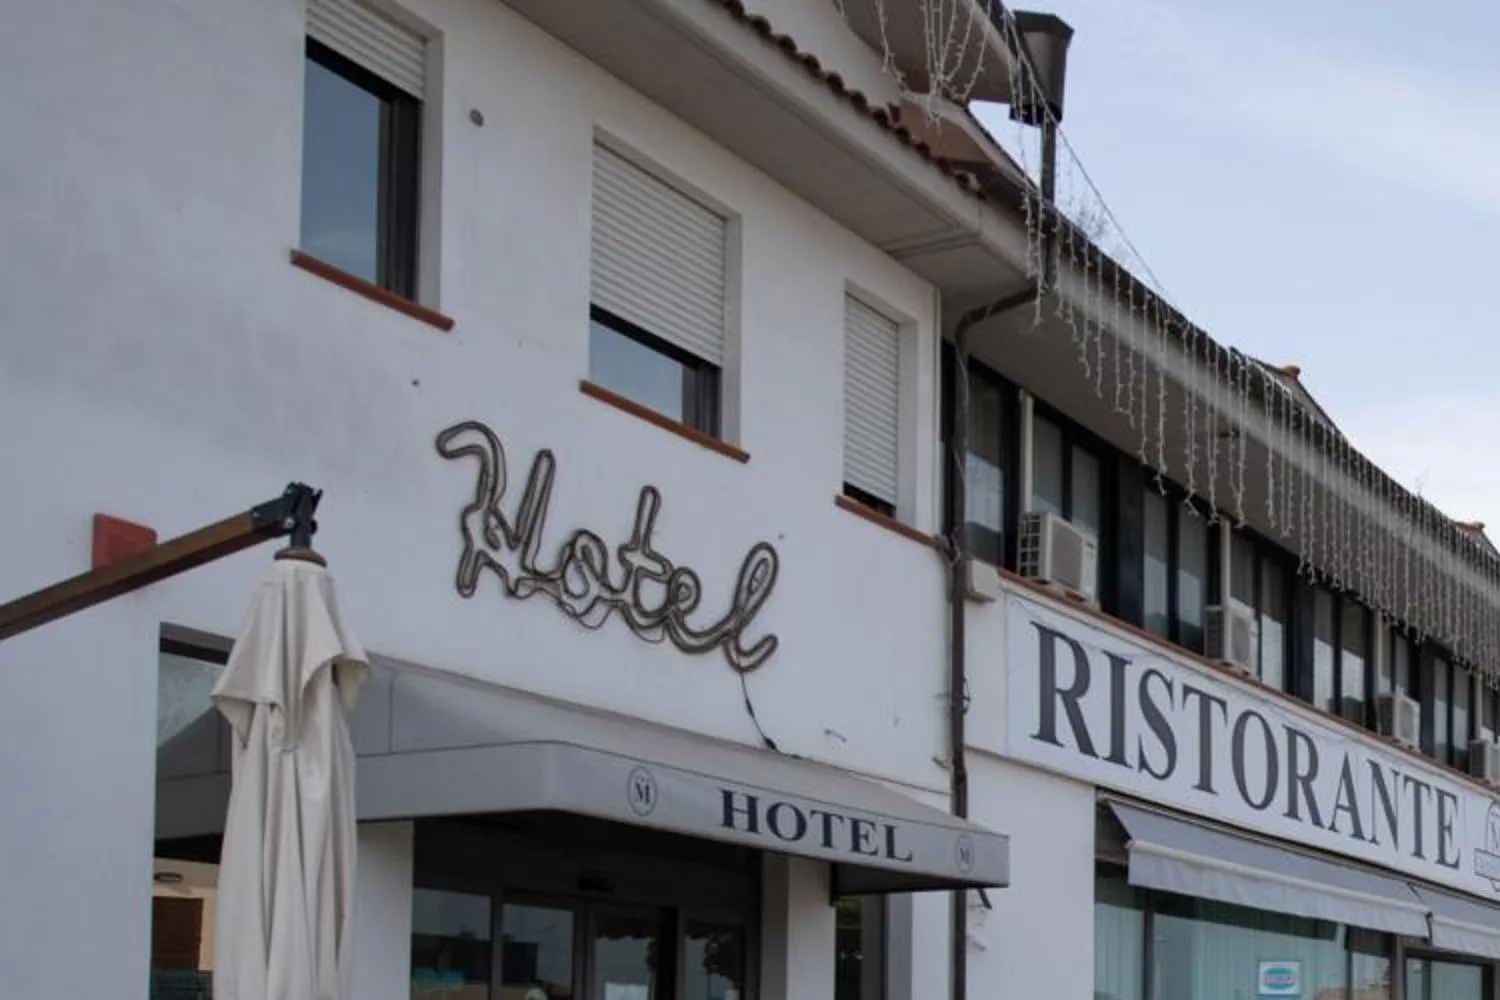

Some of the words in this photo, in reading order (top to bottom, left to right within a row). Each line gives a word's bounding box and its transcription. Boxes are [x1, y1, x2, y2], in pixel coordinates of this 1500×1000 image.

[435, 420, 779, 673] Hotel
[719, 788, 913, 863] HOTEL
[1031, 622, 1460, 868] RISTORANTE
